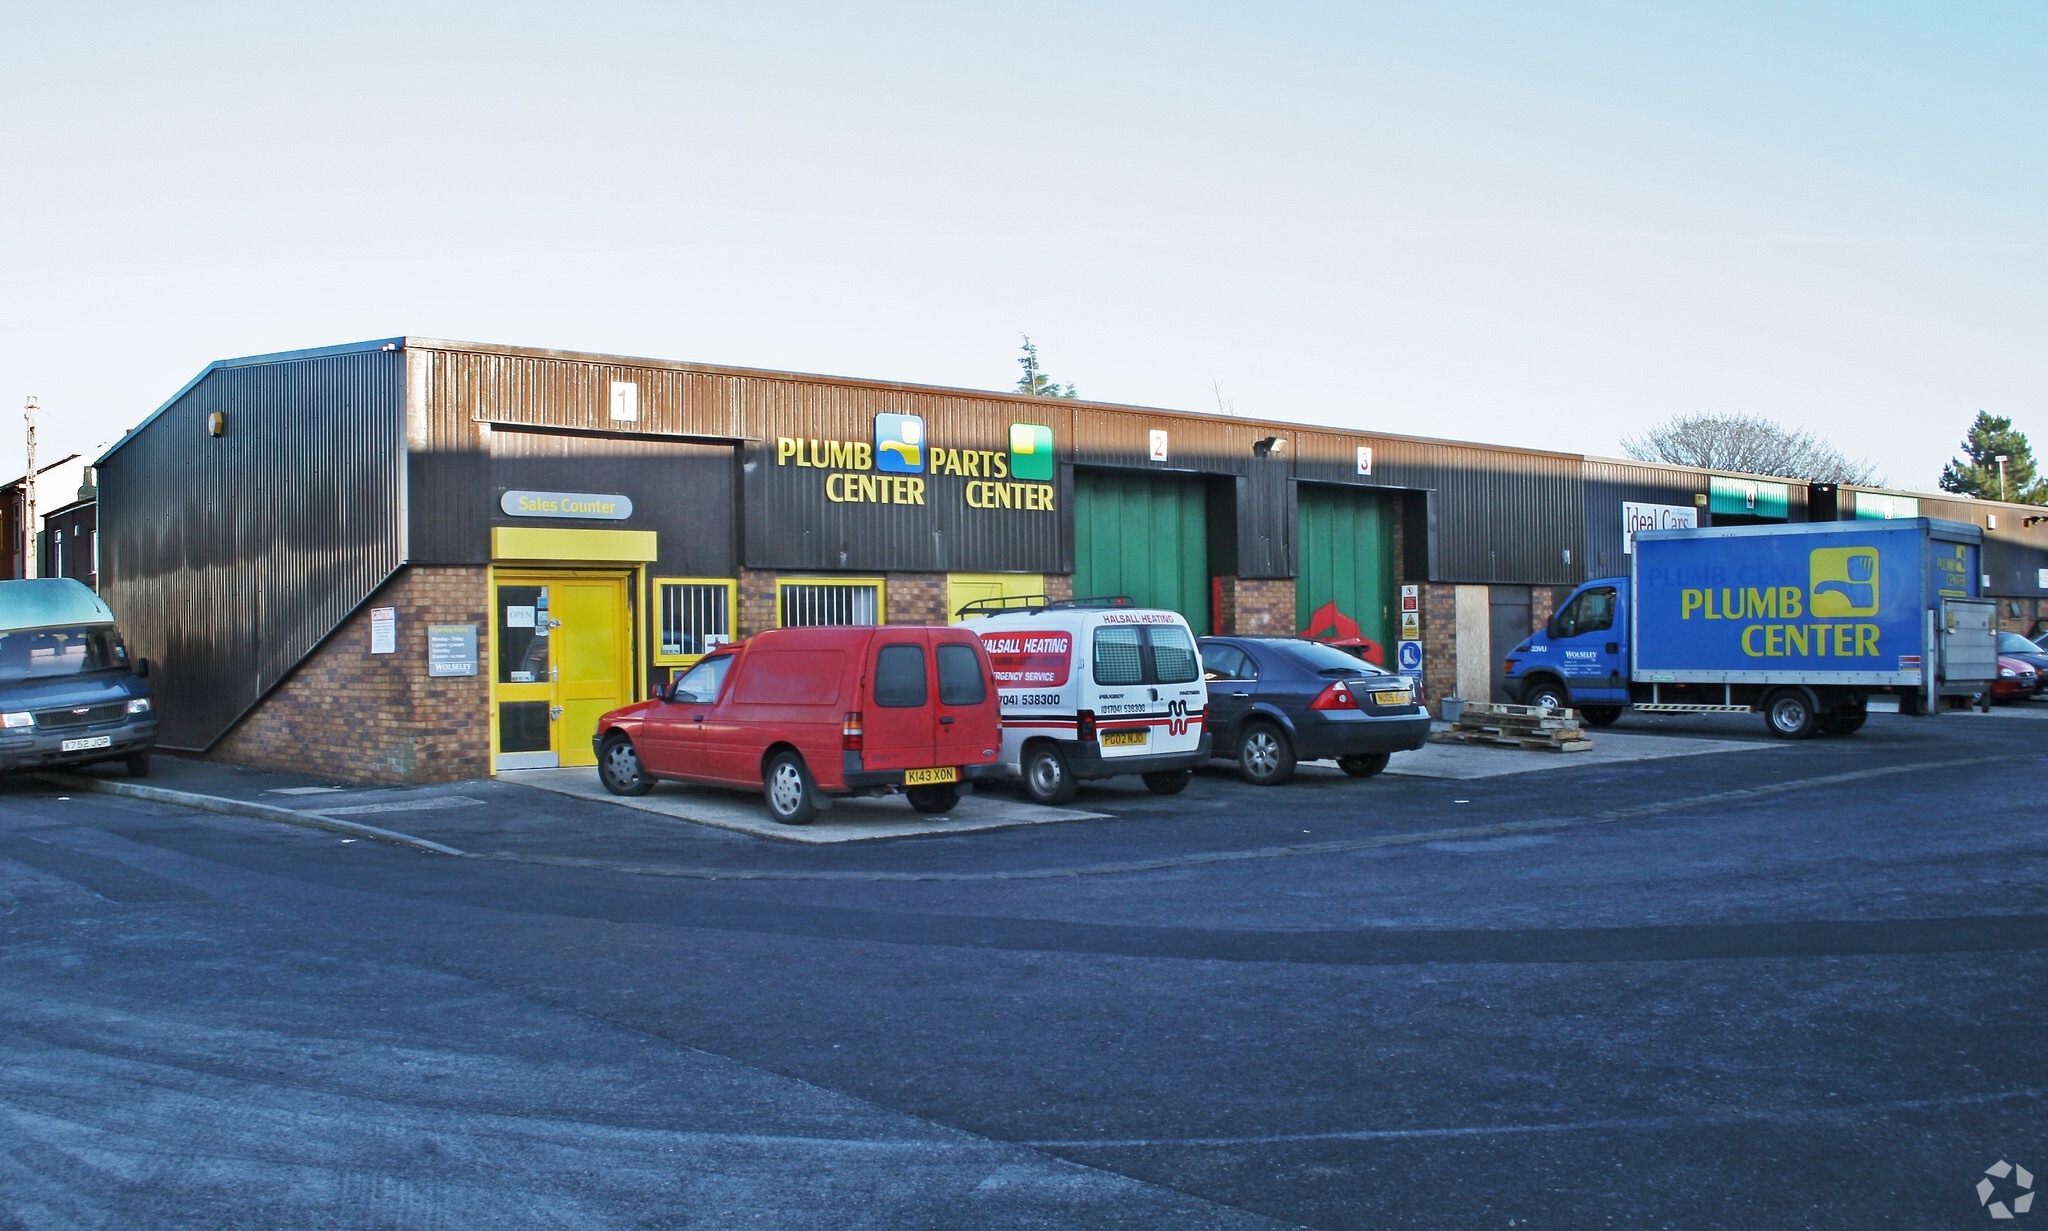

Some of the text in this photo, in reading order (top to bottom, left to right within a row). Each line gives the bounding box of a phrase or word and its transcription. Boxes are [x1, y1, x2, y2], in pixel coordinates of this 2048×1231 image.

[777, 436, 872, 471] PLUMB
[1154, 436, 1163, 457] 2
[929, 447, 1008, 478] PARTS
[1361, 452, 1369, 471] 3
[825, 473, 925, 505] CENTER
[965, 480, 1055, 511] CENTER
[518, 496, 616, 514] Sales Counter
[1625, 506, 1689, 533] Ideal Cars
[1681, 586, 1803, 620] PLUMB
[509, 610, 532, 619] OPEN
[1103, 615, 1174, 623] HALSALL HEATING
[1023, 638, 1069, 654] HEATING
[1741, 623, 1881, 657] CENTER
[1565, 650, 1598, 659] WOLSELEY
[435, 663, 472, 671] WOLSELEY
[1024, 671, 1055, 682] SERVICE
[1021, 694, 1060, 706] 538300
[64, 740, 89, 750] X752
[1104, 734, 1126, 745] PG02
[909, 768, 953, 782] K143 XON
